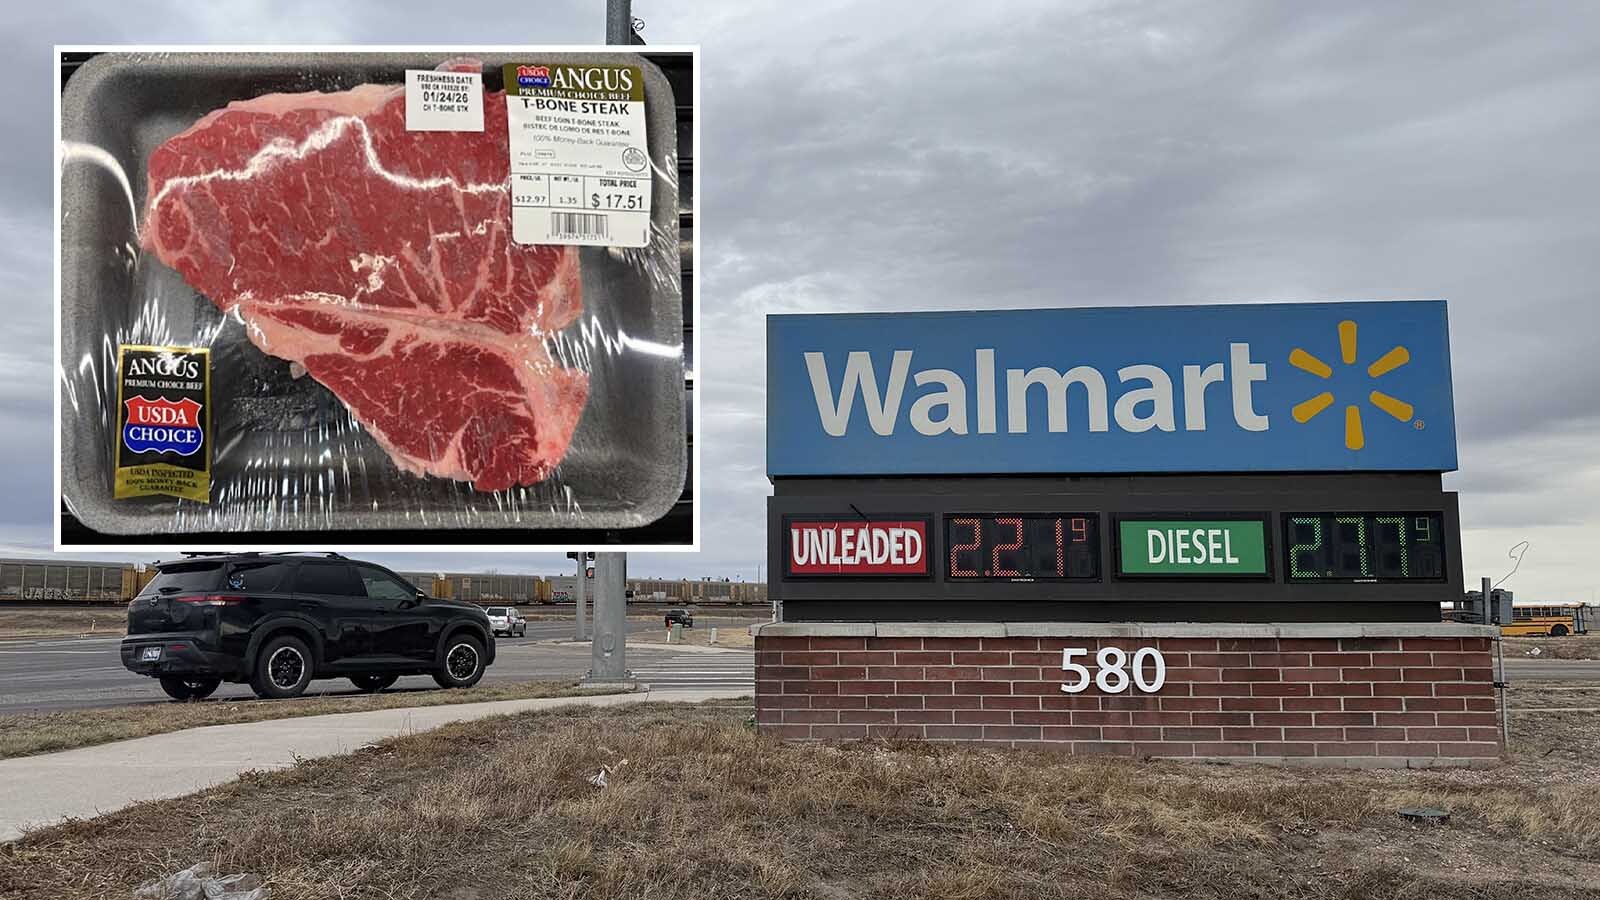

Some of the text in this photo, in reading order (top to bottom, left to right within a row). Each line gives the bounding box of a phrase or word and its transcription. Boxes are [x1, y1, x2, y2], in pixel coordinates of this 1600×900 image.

[417, 74, 473, 85] FRESHNESS DATE
[552, 66, 633, 91] ANGUS
[423, 91, 469, 104] 01/24/26
[519, 87, 631, 101] PREMIUM CHOICE BEEF
[521, 97, 630, 115] T-BONE STEAK
[597, 120, 620, 128] STEAK
[599, 178, 637, 188] TOTAL PRICE
[515, 195, 546, 204] $12.97
[559, 196, 577, 205] 1.35
[606, 194, 643, 209] 17.51
[128, 357, 199, 379] ANGUS
[124, 379, 204, 391] PREMIUM CHOICE BEEF
[803, 342, 1270, 438] Walmart
[138, 406, 189, 425] USDA
[129, 426, 197, 444] CHOICE
[791, 527, 922, 566] UNLEADED
[1147, 528, 1240, 564] DIESEL
[1060, 646, 1166, 694] 580
